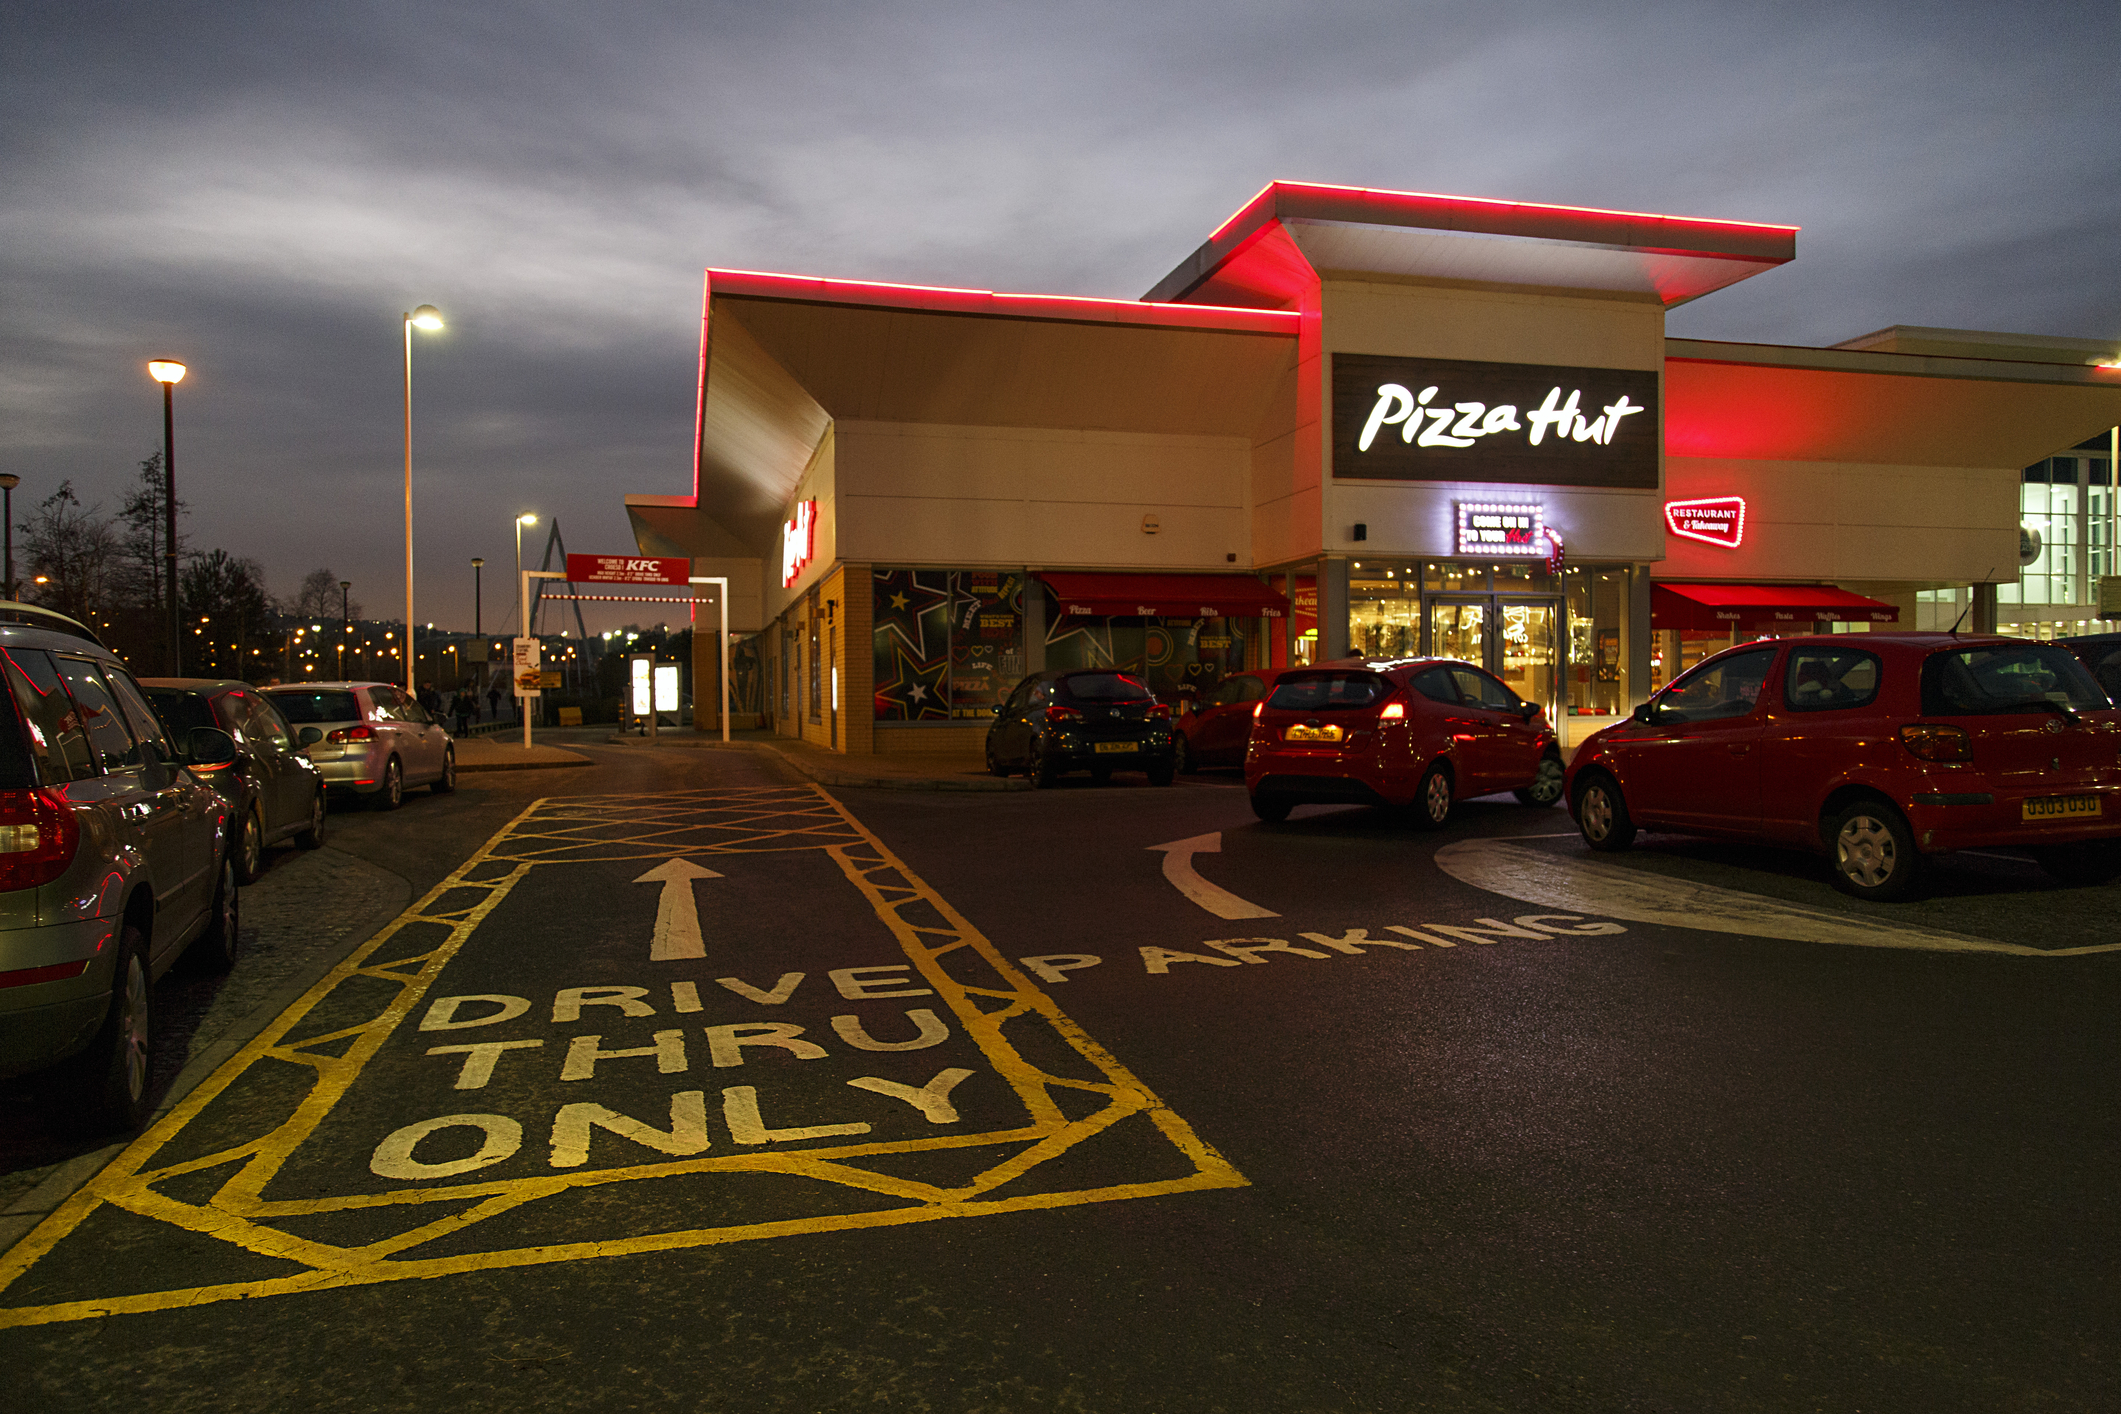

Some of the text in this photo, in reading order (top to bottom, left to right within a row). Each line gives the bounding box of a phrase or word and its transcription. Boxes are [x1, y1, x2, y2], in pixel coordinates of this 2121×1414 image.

[1358, 383, 1645, 452] Pizza Hut
[1672, 508, 1737, 519] RESTAURANT
[1472, 515, 1530, 529] COME ON IN
[1683, 519, 1730, 534] & Takeaway
[1466, 528, 1534, 544] TO YOUR Hut
[625, 559, 659, 572] KFC
[961, 599, 982, 630] MEET
[1069, 604, 1093, 615] Pizza
[1137, 605, 1157, 615] Beer
[1199, 606, 1219, 617] Ribs
[1261, 607, 1282, 617] Fries
[1716, 611, 1741, 620] Shakes
[1774, 611, 1794, 620] Pasta
[1816, 611, 1841, 622] Waffles
[1870, 612, 1893, 622] Wings
[979, 618, 1015, 628] BEST
[1199, 640, 1232, 649] BEST
[971, 661, 993, 671] LIFE
[952, 680, 990, 691] PIZZA
[1177, 683, 1197, 693] LIFE
[962, 709, 975, 718] THE
[1019, 915, 1628, 983] PARKING
[418, 965, 933, 1031] DRIVE
[425, 1009, 950, 1091] THRU
[369, 1068, 976, 1180] ONLY
